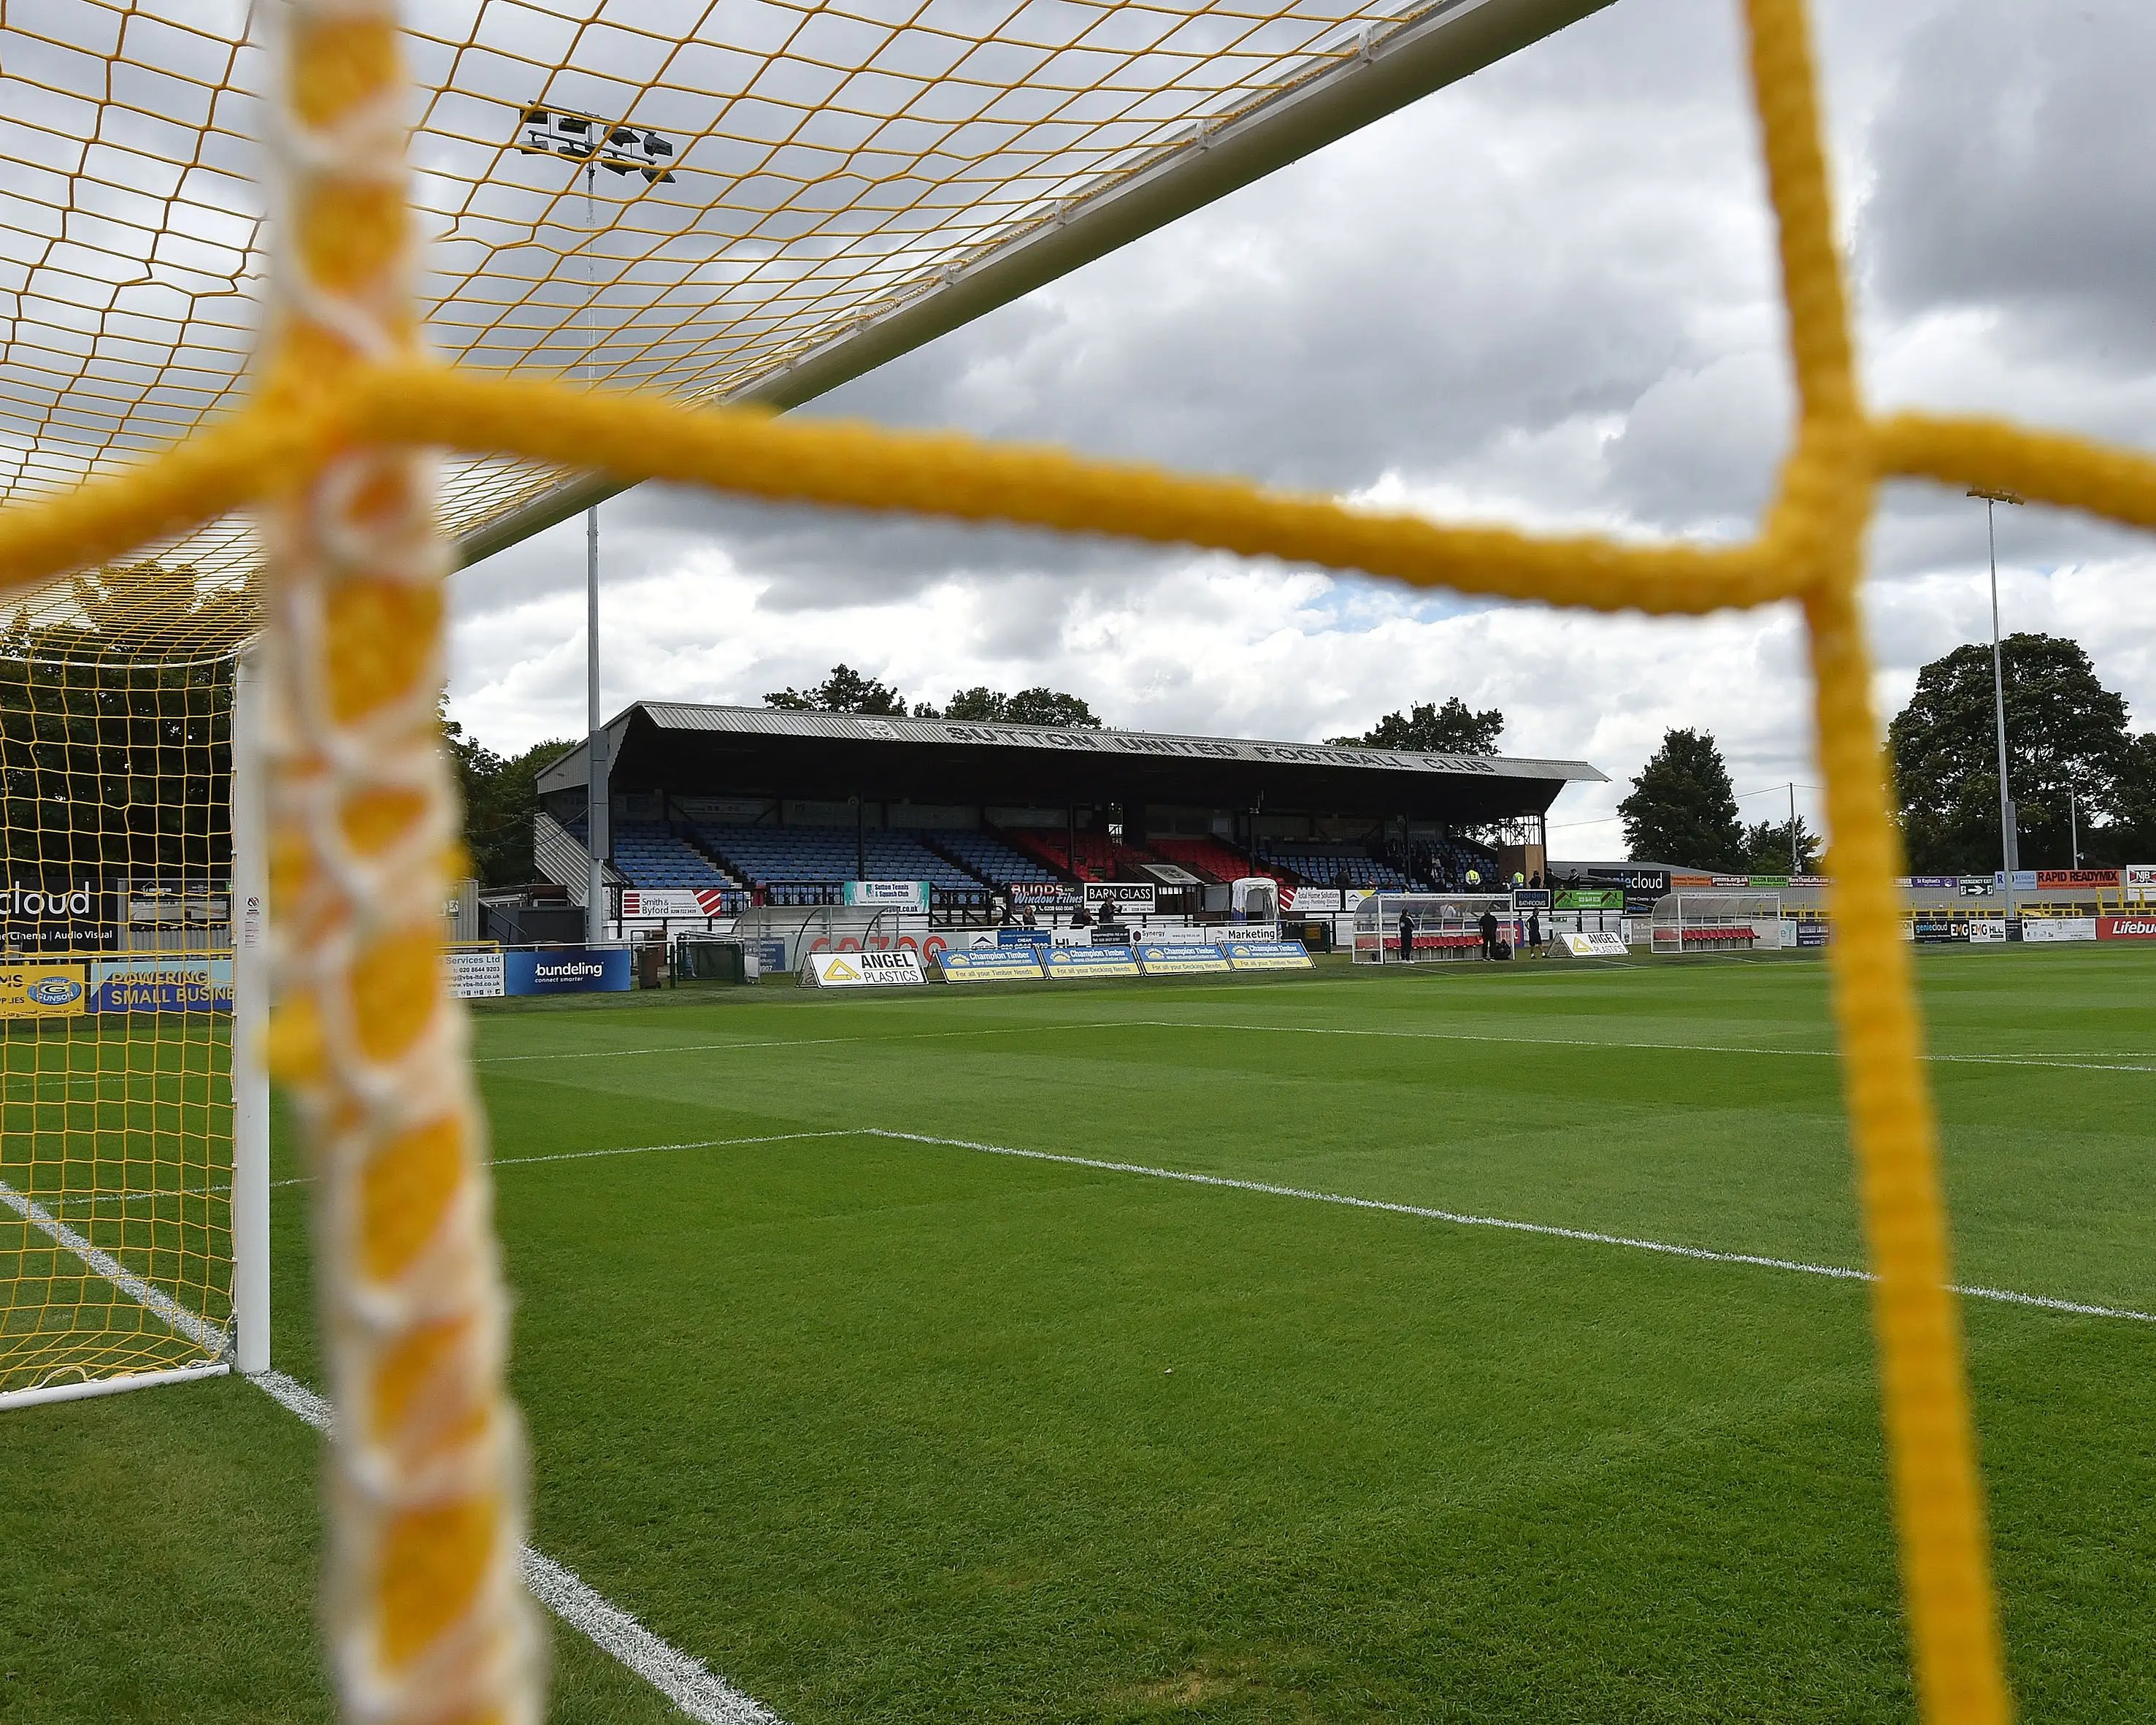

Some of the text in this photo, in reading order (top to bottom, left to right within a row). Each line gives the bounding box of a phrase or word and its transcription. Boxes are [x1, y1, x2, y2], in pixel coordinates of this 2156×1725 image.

[946, 727, 1496, 773] SUTTON UNITED FOOTBALL CLUB
[2038, 871, 2117, 882] RAPID READYMIX
[2136, 871, 2150, 882] NJB
[1011, 884, 1064, 895] BLINDS
[1089, 889, 1151, 899] BARN GLASS
[1014, 892, 1055, 903] Window
[1056, 892, 1083, 903] Films
[642, 906, 669, 915] Byford
[1916, 921, 1947, 933] geniecloud
[1950, 924, 1969, 936] EMG
[1971, 923, 1987, 936] EMG
[2112, 921, 2156, 934] Lifebu
[55, 931, 83, 939] Audio
[85, 930, 112, 939] Visual
[1228, 929, 1275, 940] Marketing
[1587, 934, 1619, 944] ANGEL
[1070, 949, 1105, 957] Champion
[1163, 947, 1194, 955] Champion
[1593, 944, 1625, 954] PLASTICS
[862, 953, 914, 968] ANGEL
[969, 952, 1005, 960] Champion
[535, 962, 602, 976] bundeling
[111, 971, 210, 986] POWERING
[864, 971, 918, 983] PLASTICS
[37, 992, 74, 1002] GUNSON
[111, 988, 171, 1005] SMALL
